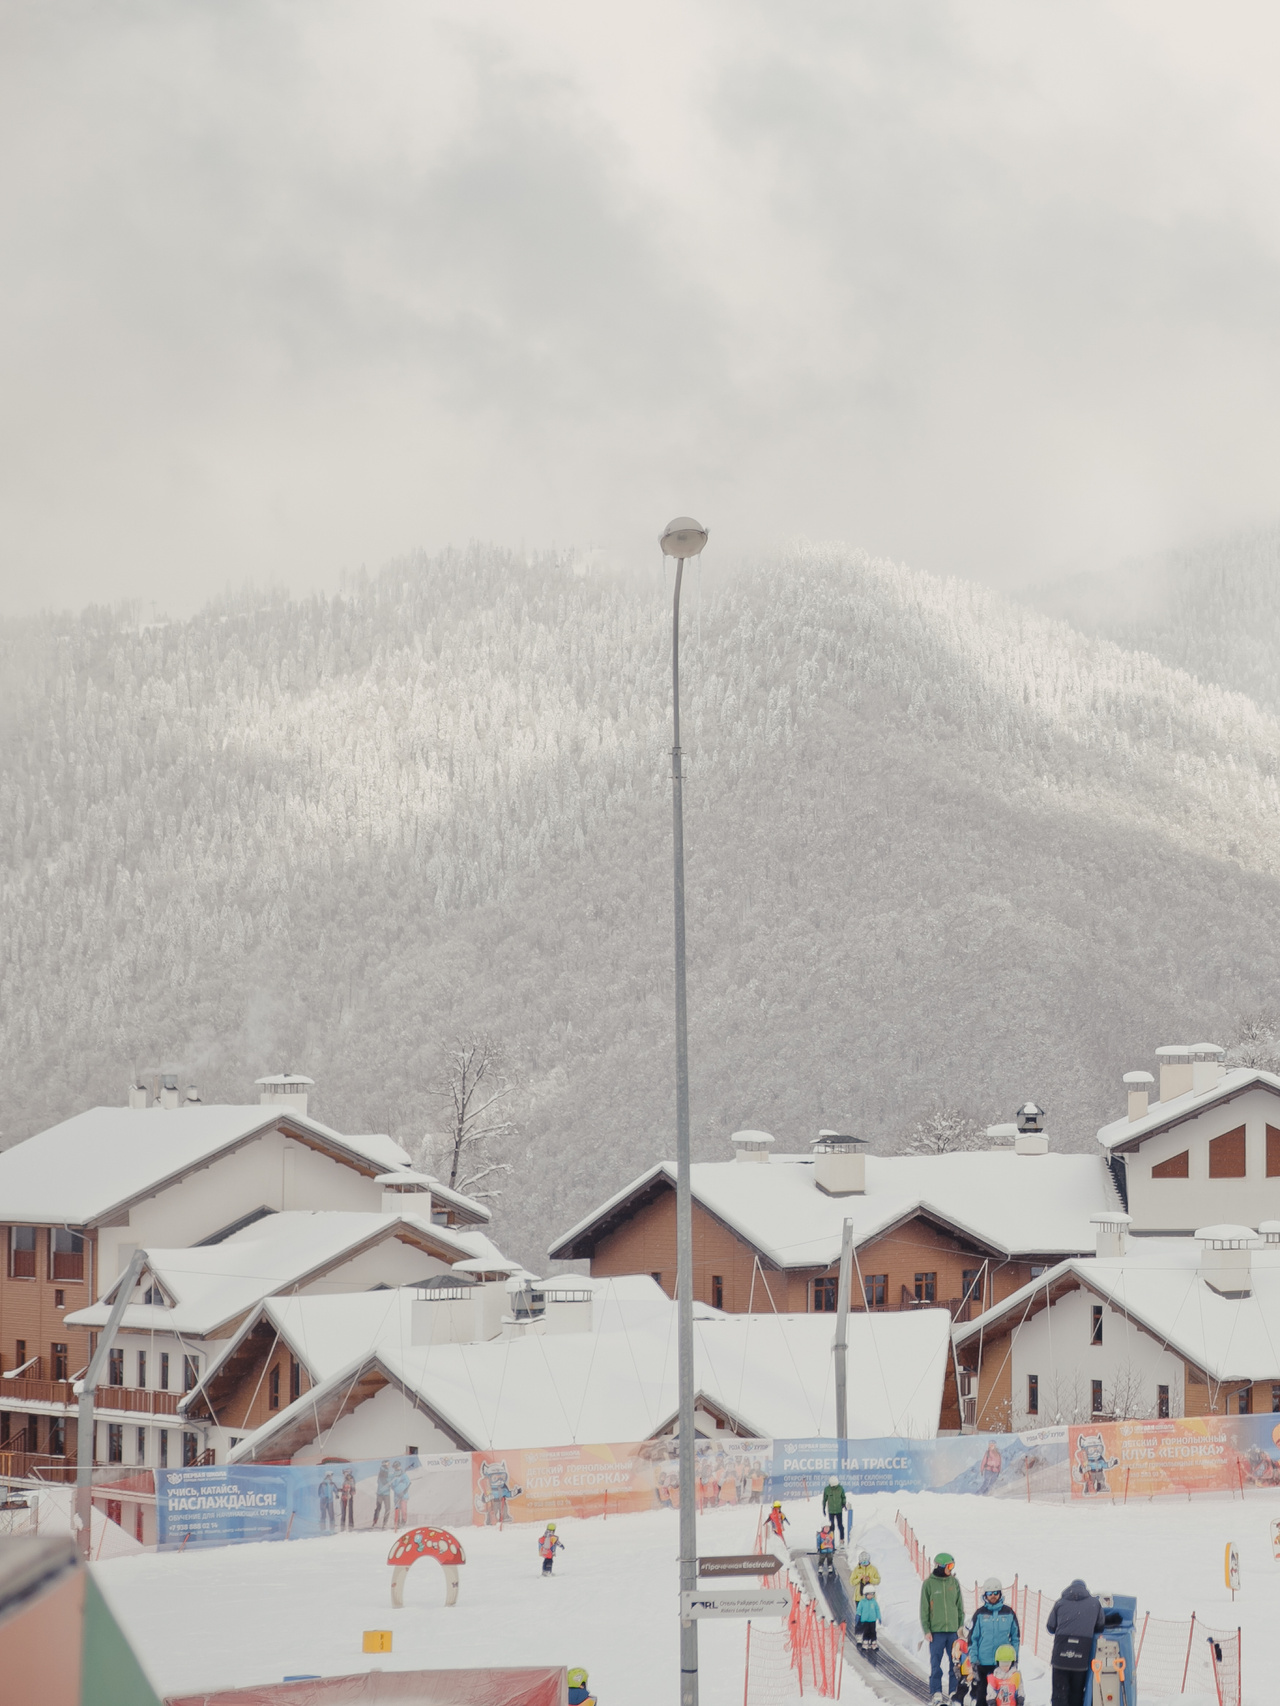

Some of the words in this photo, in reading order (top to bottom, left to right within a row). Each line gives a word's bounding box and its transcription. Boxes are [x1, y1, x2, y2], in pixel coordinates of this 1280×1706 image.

[1122, 1437, 1158, 1448] ДЕТСКИЙ
[1161, 1433, 1227, 1446] ГОРНОЛЫЖНЫЙ
[1121, 1449, 1155, 1461] КЛУБ
[1158, 1445, 1224, 1459] «ЕГОРКА»
[527, 1464, 563, 1476] ДЕТСКИЙ
[566, 1460, 632, 1473] ГОРНОЛЫЖНЫЙ
[783, 1459, 838, 1470] РАССВЕТ
[841, 1459, 859, 1470] НА
[862, 1457, 907, 1469] ТРАССЕ
[526, 1476, 560, 1489] КЛУБ
[564, 1473, 630, 1486] «ЕГОРКА»
[167, 1487, 199, 1497] УЧИСЬ,
[200, 1484, 240, 1495] КАТАЙСЯ,
[168, 1491, 277, 1511] НАСЛАЖДАЙСЯ!
[168, 1513, 201, 1521] ОБУЧЕНИЕ
[202, 1512, 215, 1520] ДЛЯ
